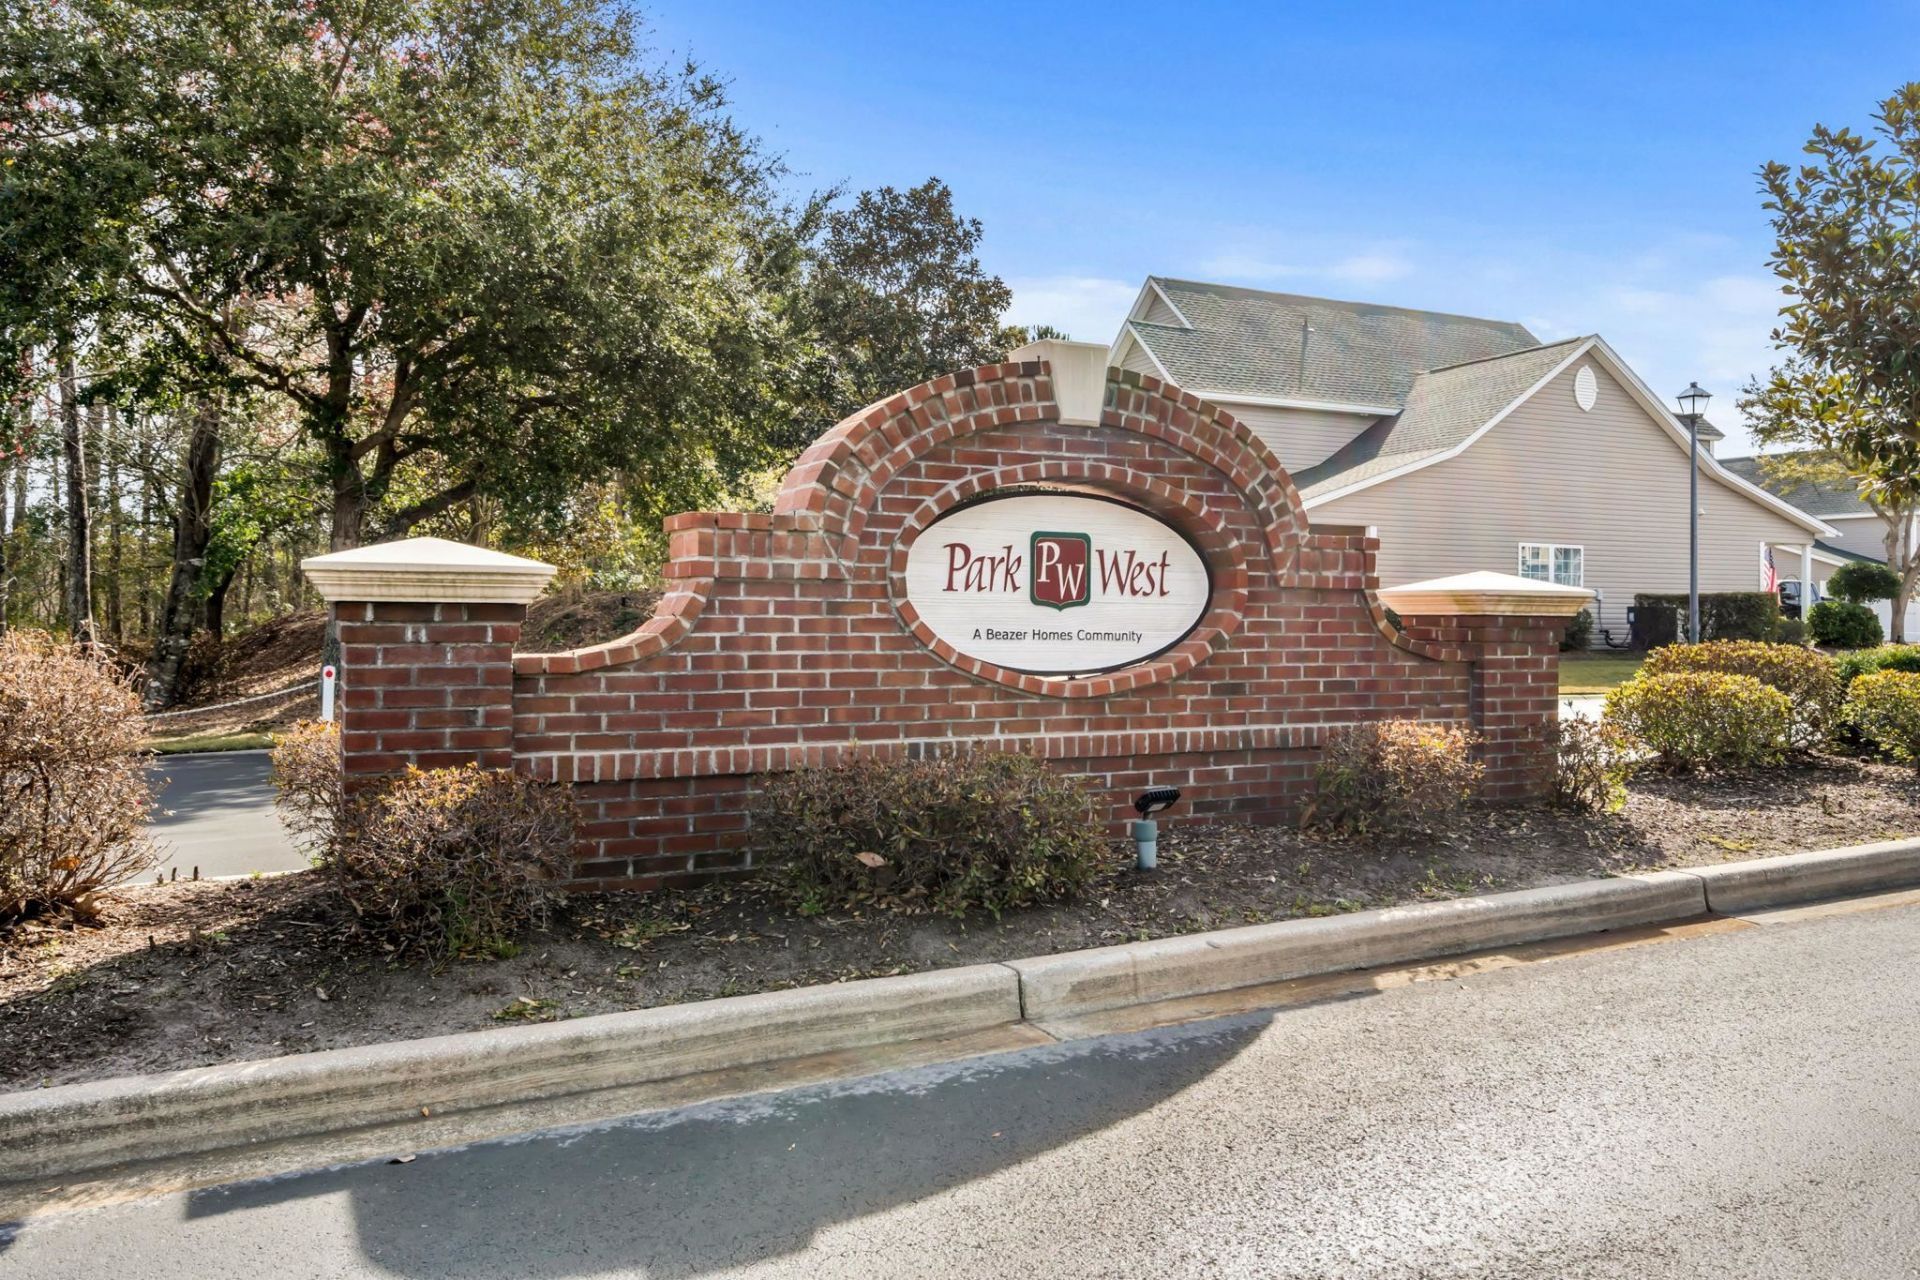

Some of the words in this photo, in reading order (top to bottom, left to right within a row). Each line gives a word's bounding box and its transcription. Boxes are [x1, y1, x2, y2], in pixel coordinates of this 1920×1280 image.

[943, 542, 1022, 593] Park
[1096, 549, 1171, 597] West
[973, 629, 982, 640] A
[986, 629, 1028, 641] Beazer
[1032, 629, 1073, 641] Homes
[1077, 630, 1143, 644] Community
